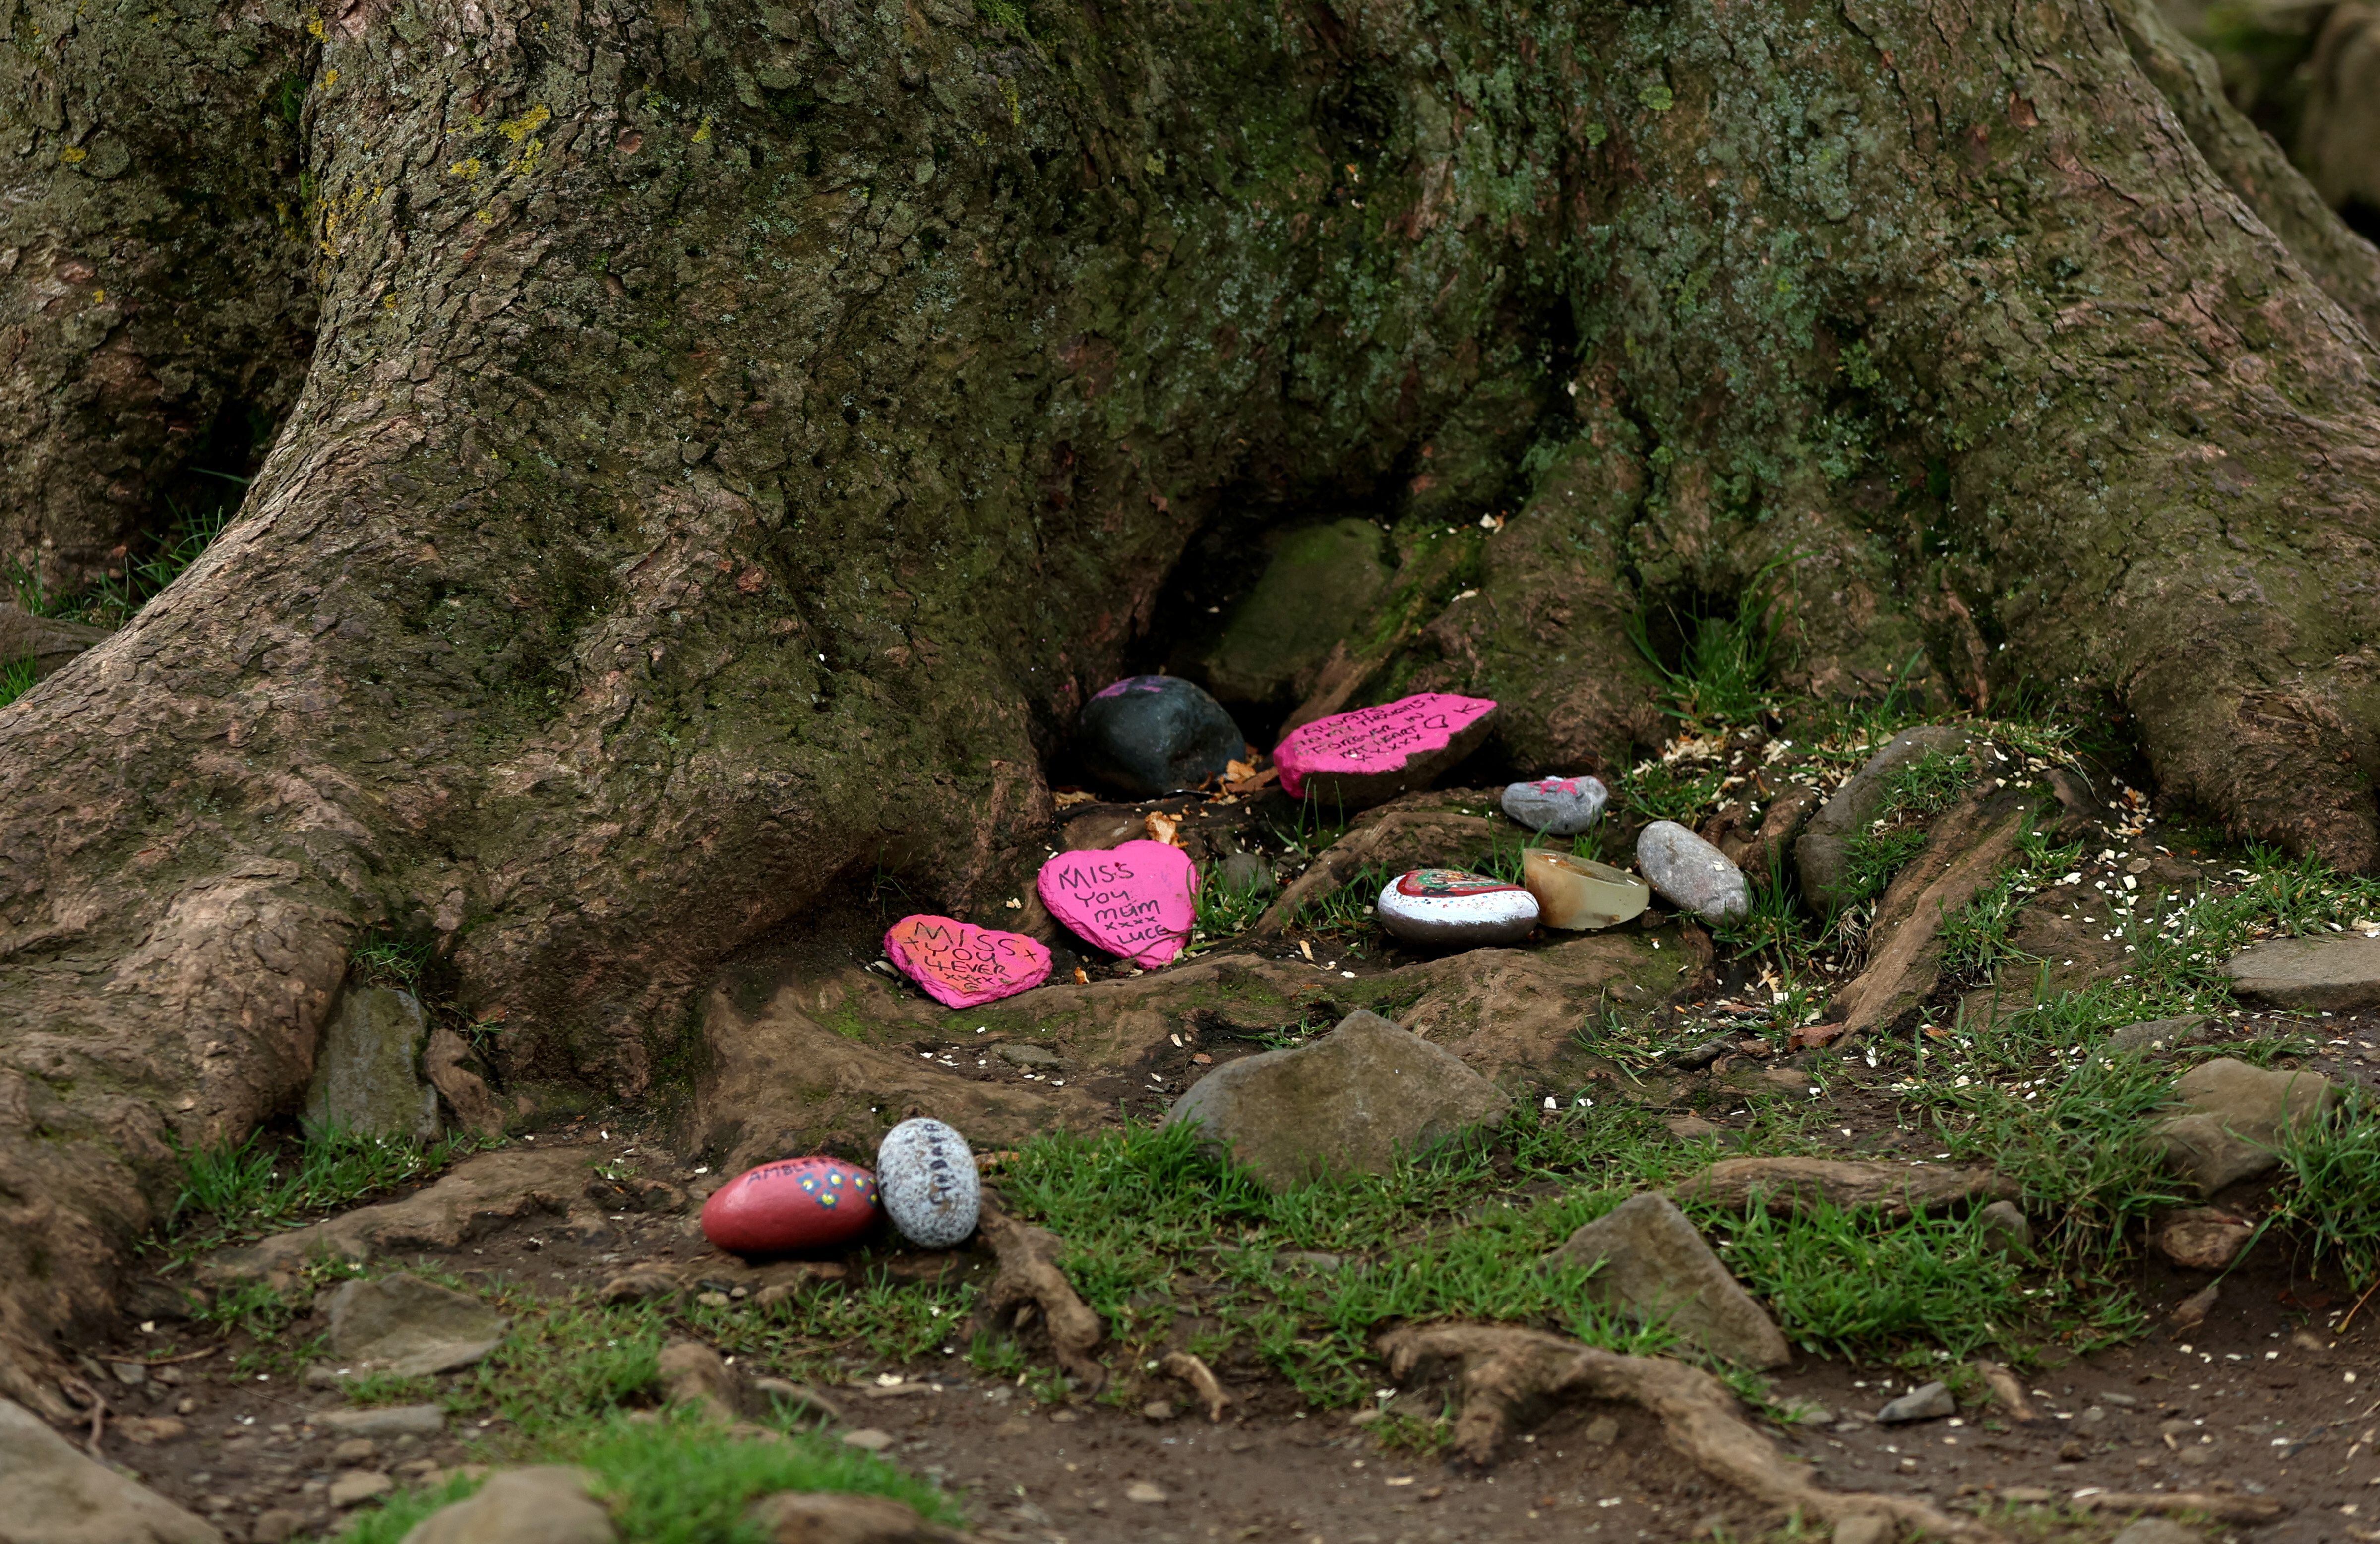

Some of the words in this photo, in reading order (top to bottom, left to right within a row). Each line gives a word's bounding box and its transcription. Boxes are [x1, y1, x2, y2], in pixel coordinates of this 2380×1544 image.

[1404, 712, 1424, 723] IN
[1058, 863, 1135, 890] MISS
[914, 921, 1020, 956] MISS
[1117, 924, 1169, 944] LUCE
[925, 942, 998, 967] YOU
[925, 955, 1011, 978] 4EVER
